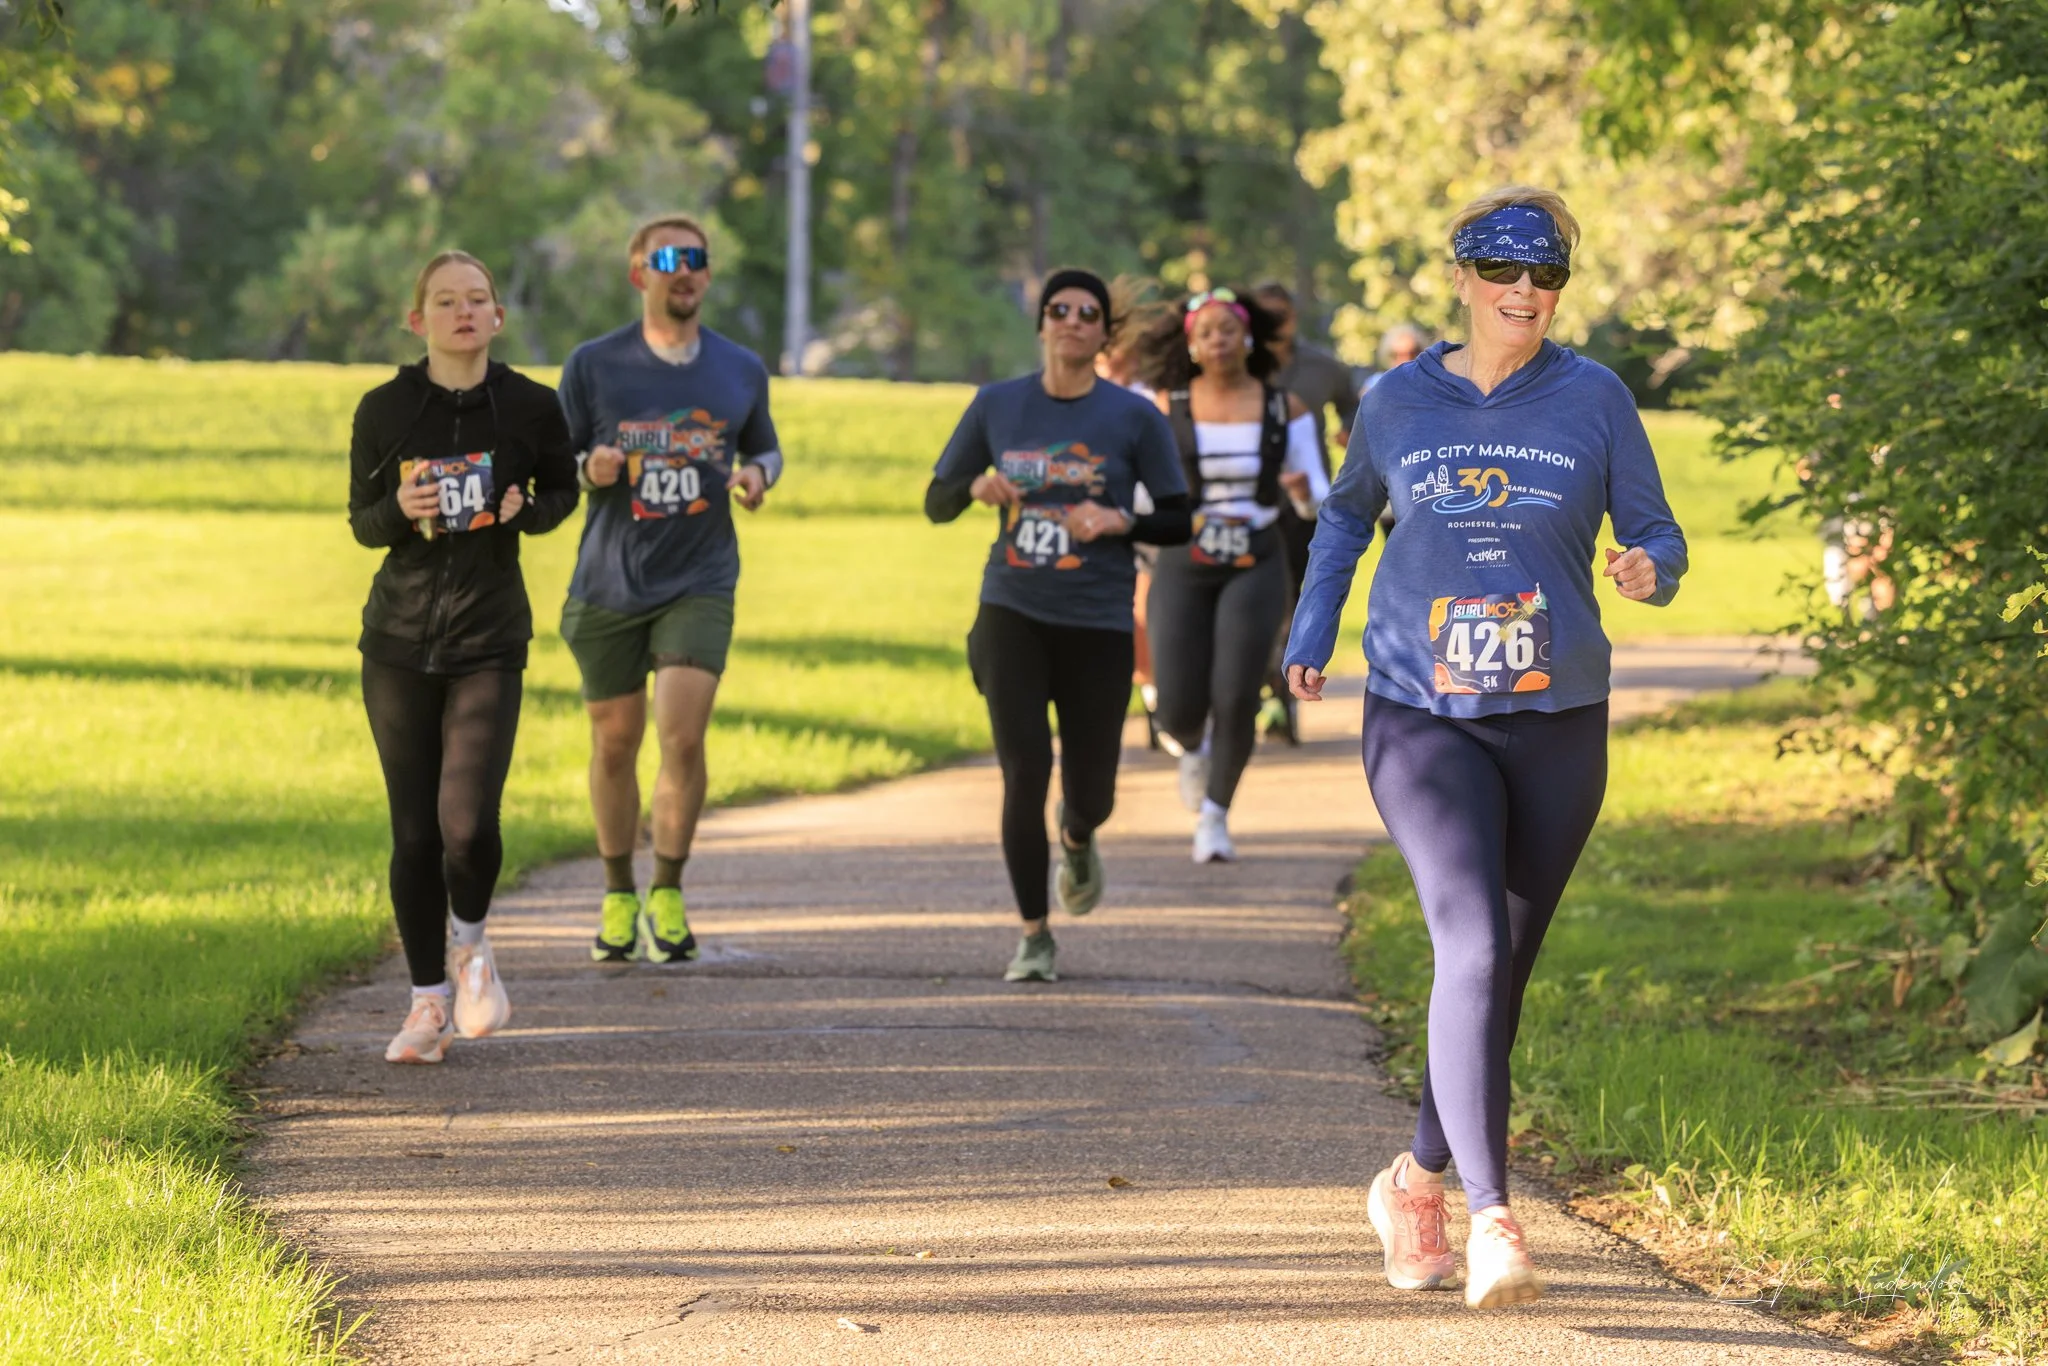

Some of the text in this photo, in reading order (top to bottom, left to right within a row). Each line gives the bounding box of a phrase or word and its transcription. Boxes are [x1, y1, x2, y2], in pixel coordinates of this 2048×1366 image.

[1401, 444, 1576, 471] MED CITY MARATHON
[438, 473, 486, 517] 64
[640, 465, 701, 504] 420
[1457, 467, 1510, 508] 30
[1503, 484, 1563, 501] YEARS RUNNING
[1016, 520, 1069, 555] 421
[1198, 525, 1250, 555] 445
[1447, 521, 1522, 531] ROCHESTER, MINN
[1446, 620, 1535, 672] 426
[1482, 675, 1498, 688] 5K
